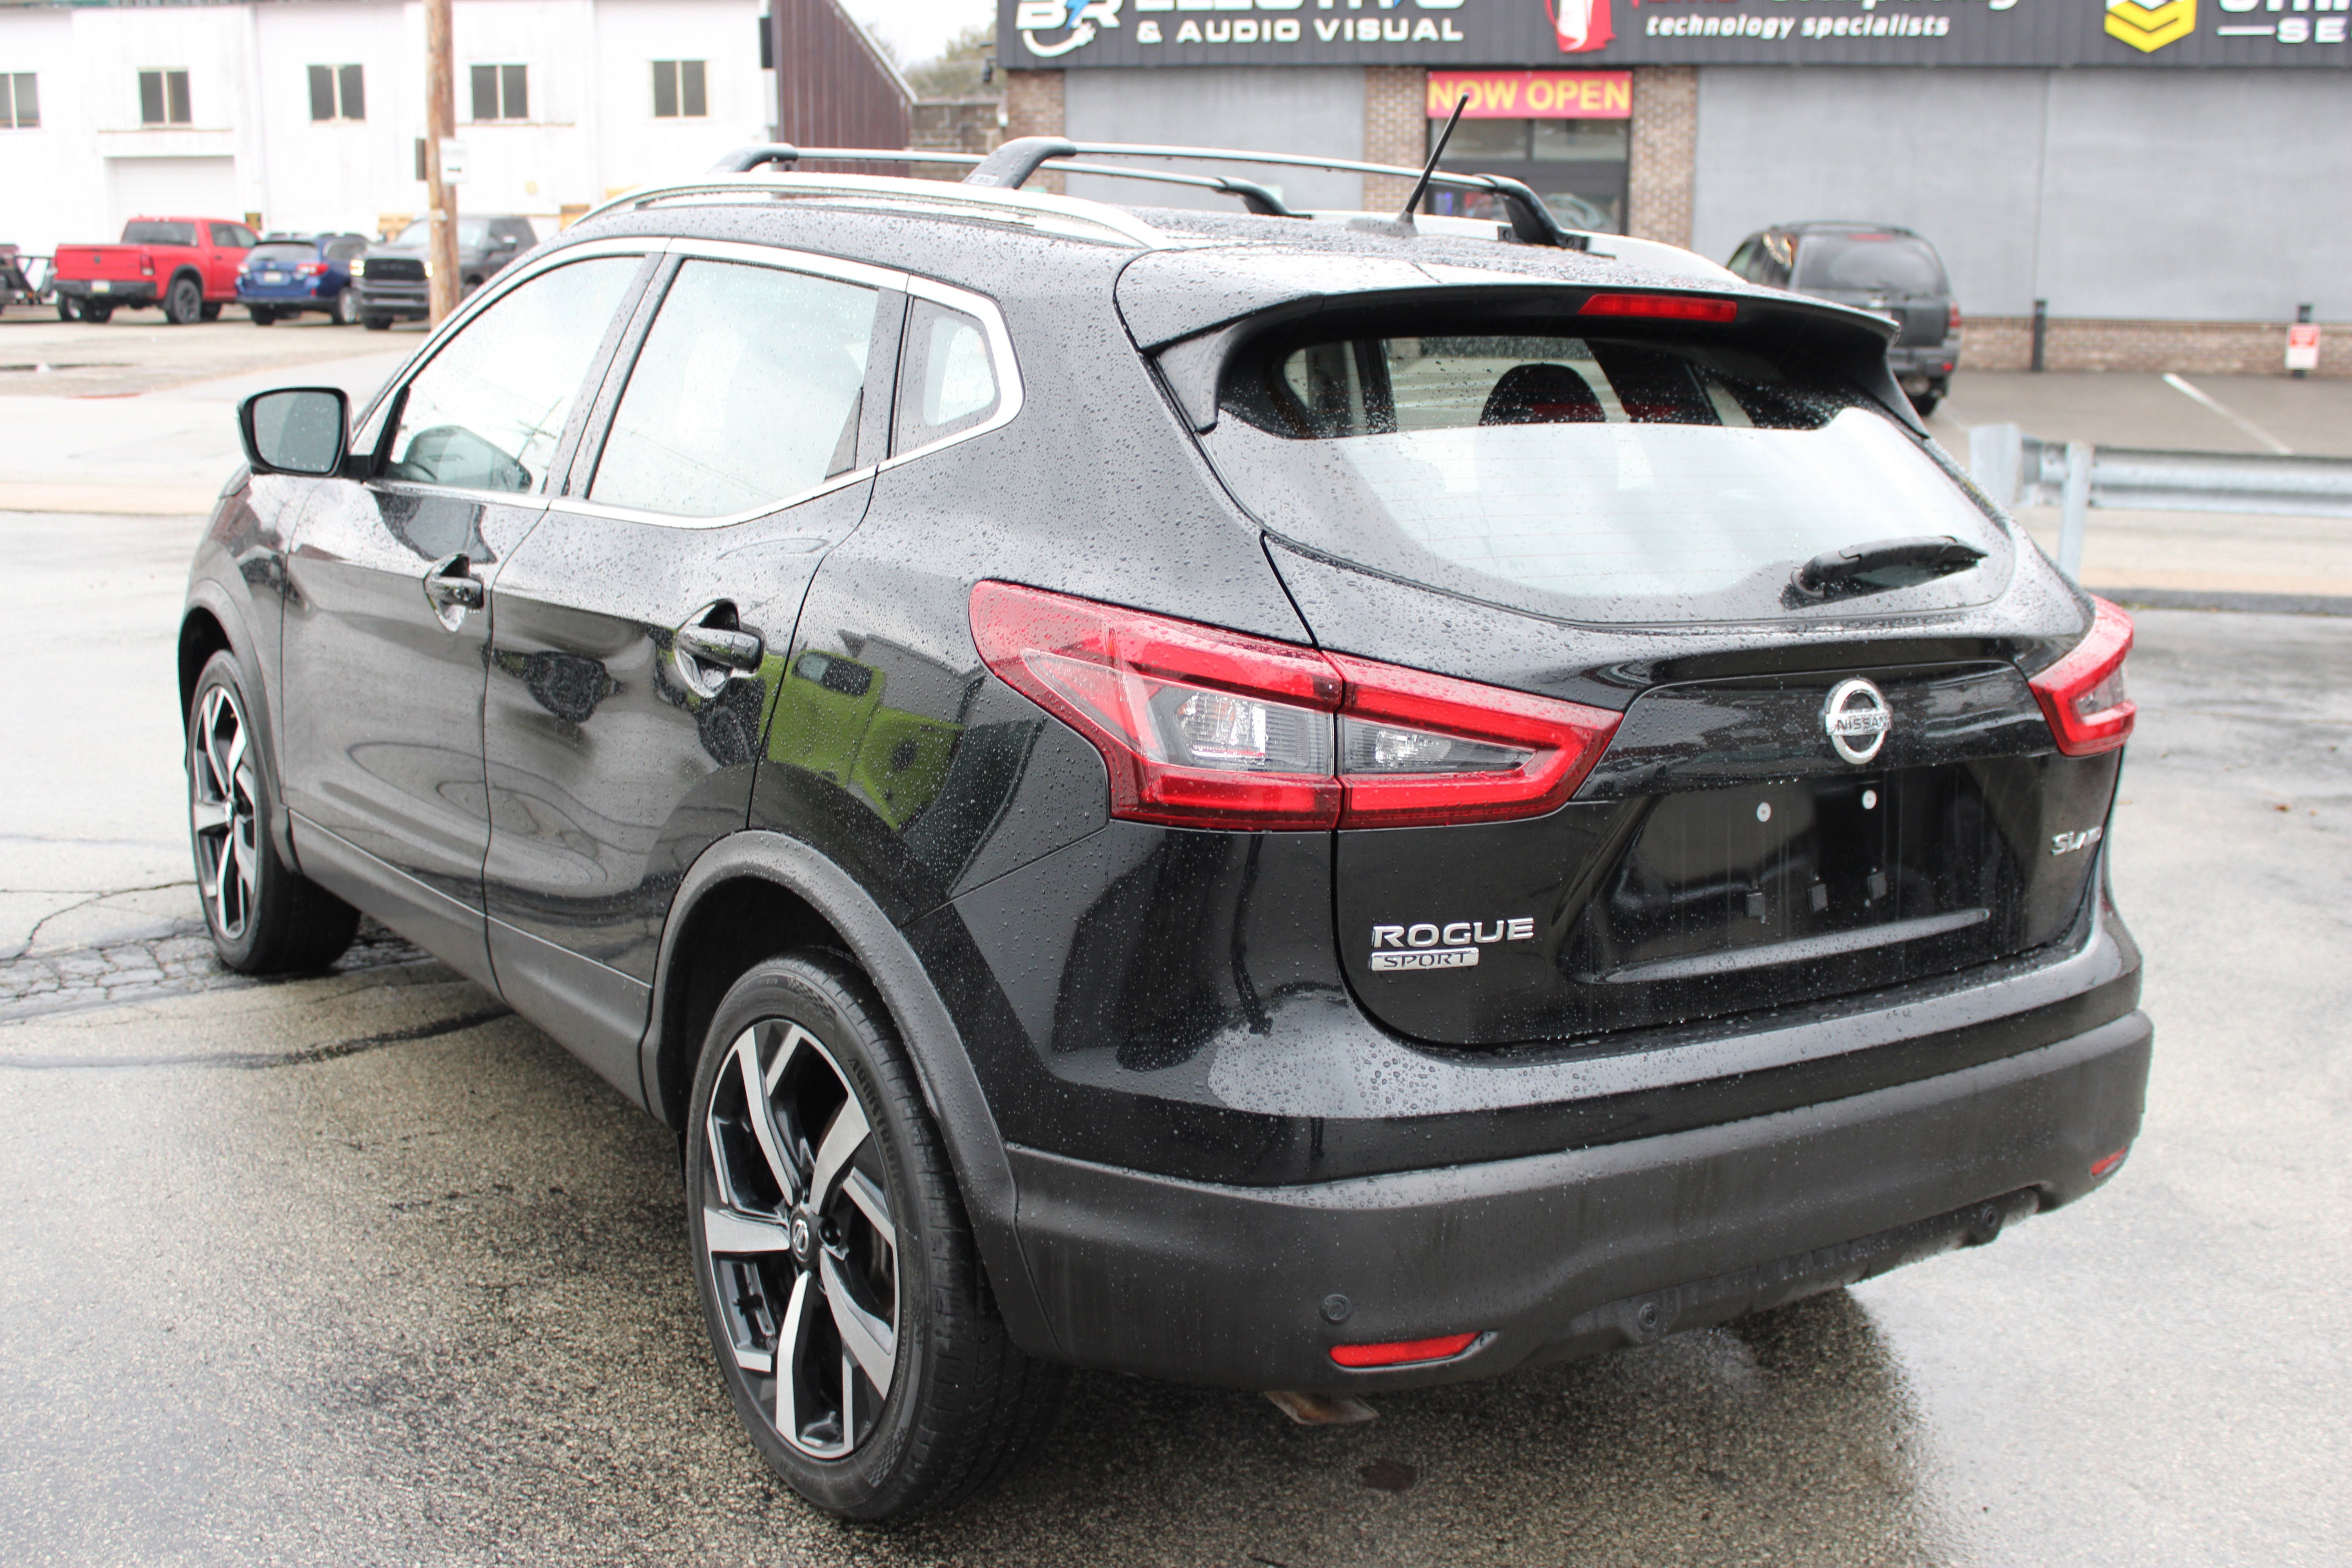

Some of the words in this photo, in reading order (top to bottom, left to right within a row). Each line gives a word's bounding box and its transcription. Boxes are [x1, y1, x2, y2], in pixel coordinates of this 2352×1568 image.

[1136, 20, 1163, 44] &
[1176, 19, 1301, 43] AUDIO
[1313, 18, 1465, 42] VISUAL
[1645, 13, 1795, 40] technology
[1800, 13, 1951, 40] specialists
[2276, 17, 2352, 44] SE
[1429, 79, 1518, 111] NOW
[1526, 79, 1630, 111] OPEN
[1837, 715, 1888, 731] NISSAN
[1372, 918, 1535, 948] ROGUE
[1383, 951, 1470, 968] SPORT
